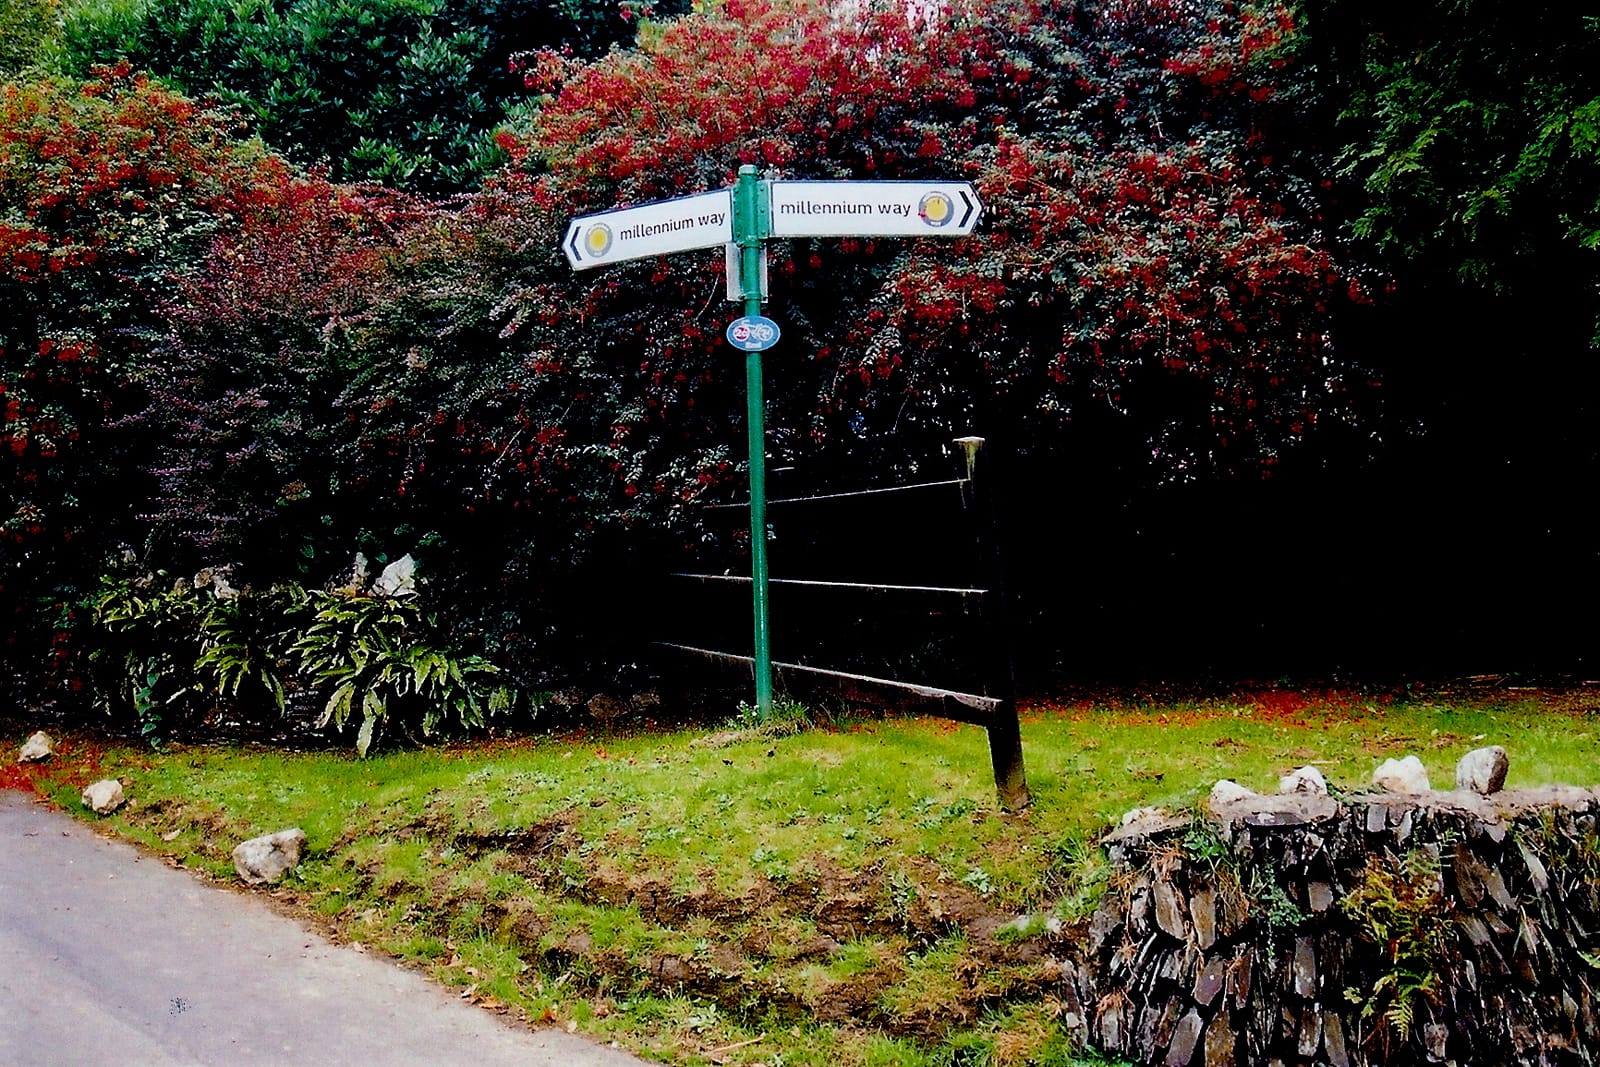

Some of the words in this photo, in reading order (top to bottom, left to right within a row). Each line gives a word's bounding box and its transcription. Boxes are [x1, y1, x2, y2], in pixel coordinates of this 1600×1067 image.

[780, 200, 872, 215] millennium
[878, 204, 911, 217] way
[620, 217, 694, 241] millennium
[698, 212, 725, 227] way
